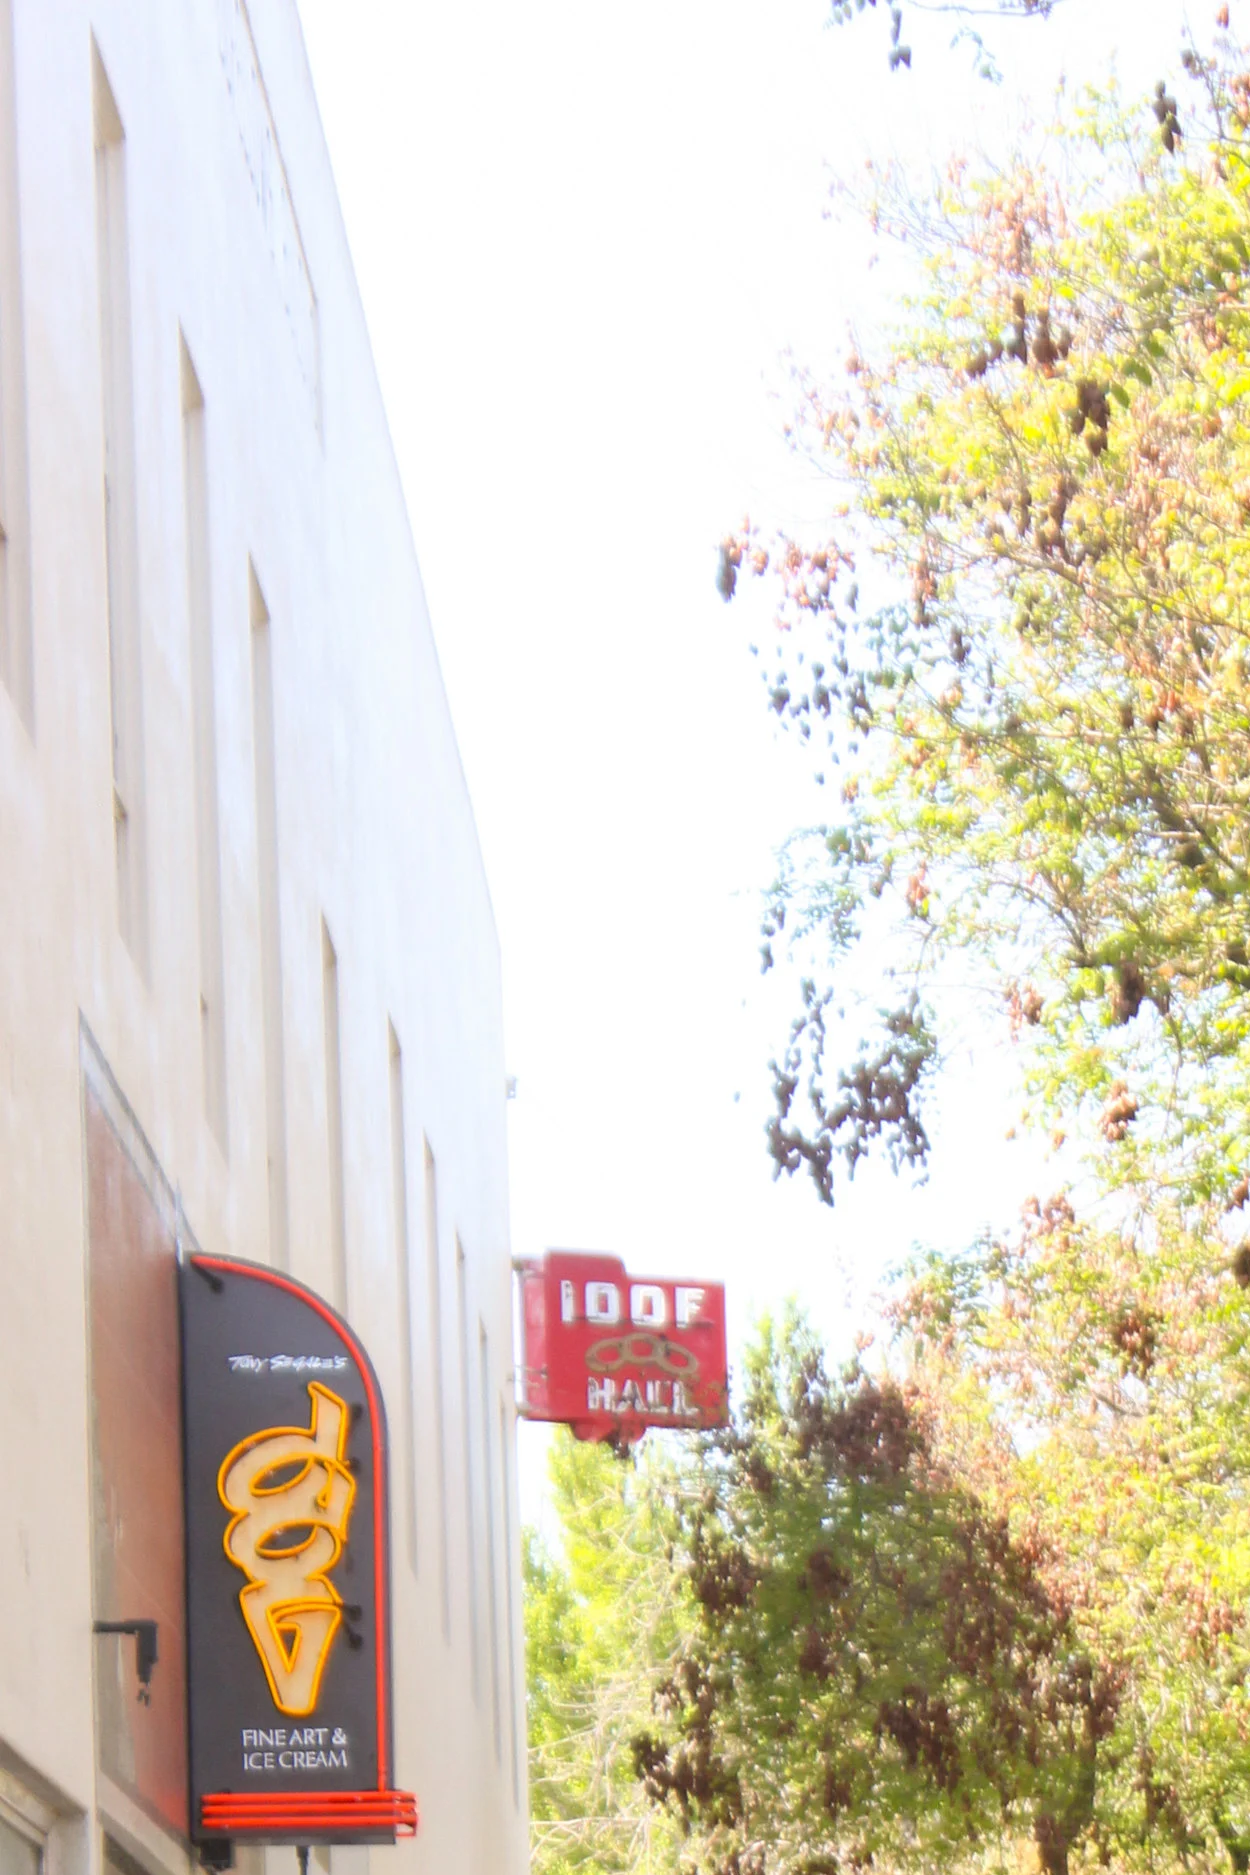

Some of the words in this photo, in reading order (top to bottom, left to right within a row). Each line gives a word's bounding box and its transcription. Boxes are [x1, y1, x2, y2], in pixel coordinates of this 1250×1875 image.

[587, 1376, 698, 1415] HALL
[242, 1729, 286, 1747] FINE
[289, 1727, 329, 1746] ART
[331, 1727, 347, 1745] &
[243, 1751, 275, 1770] ICE
[278, 1749, 348, 1769] CREAM
